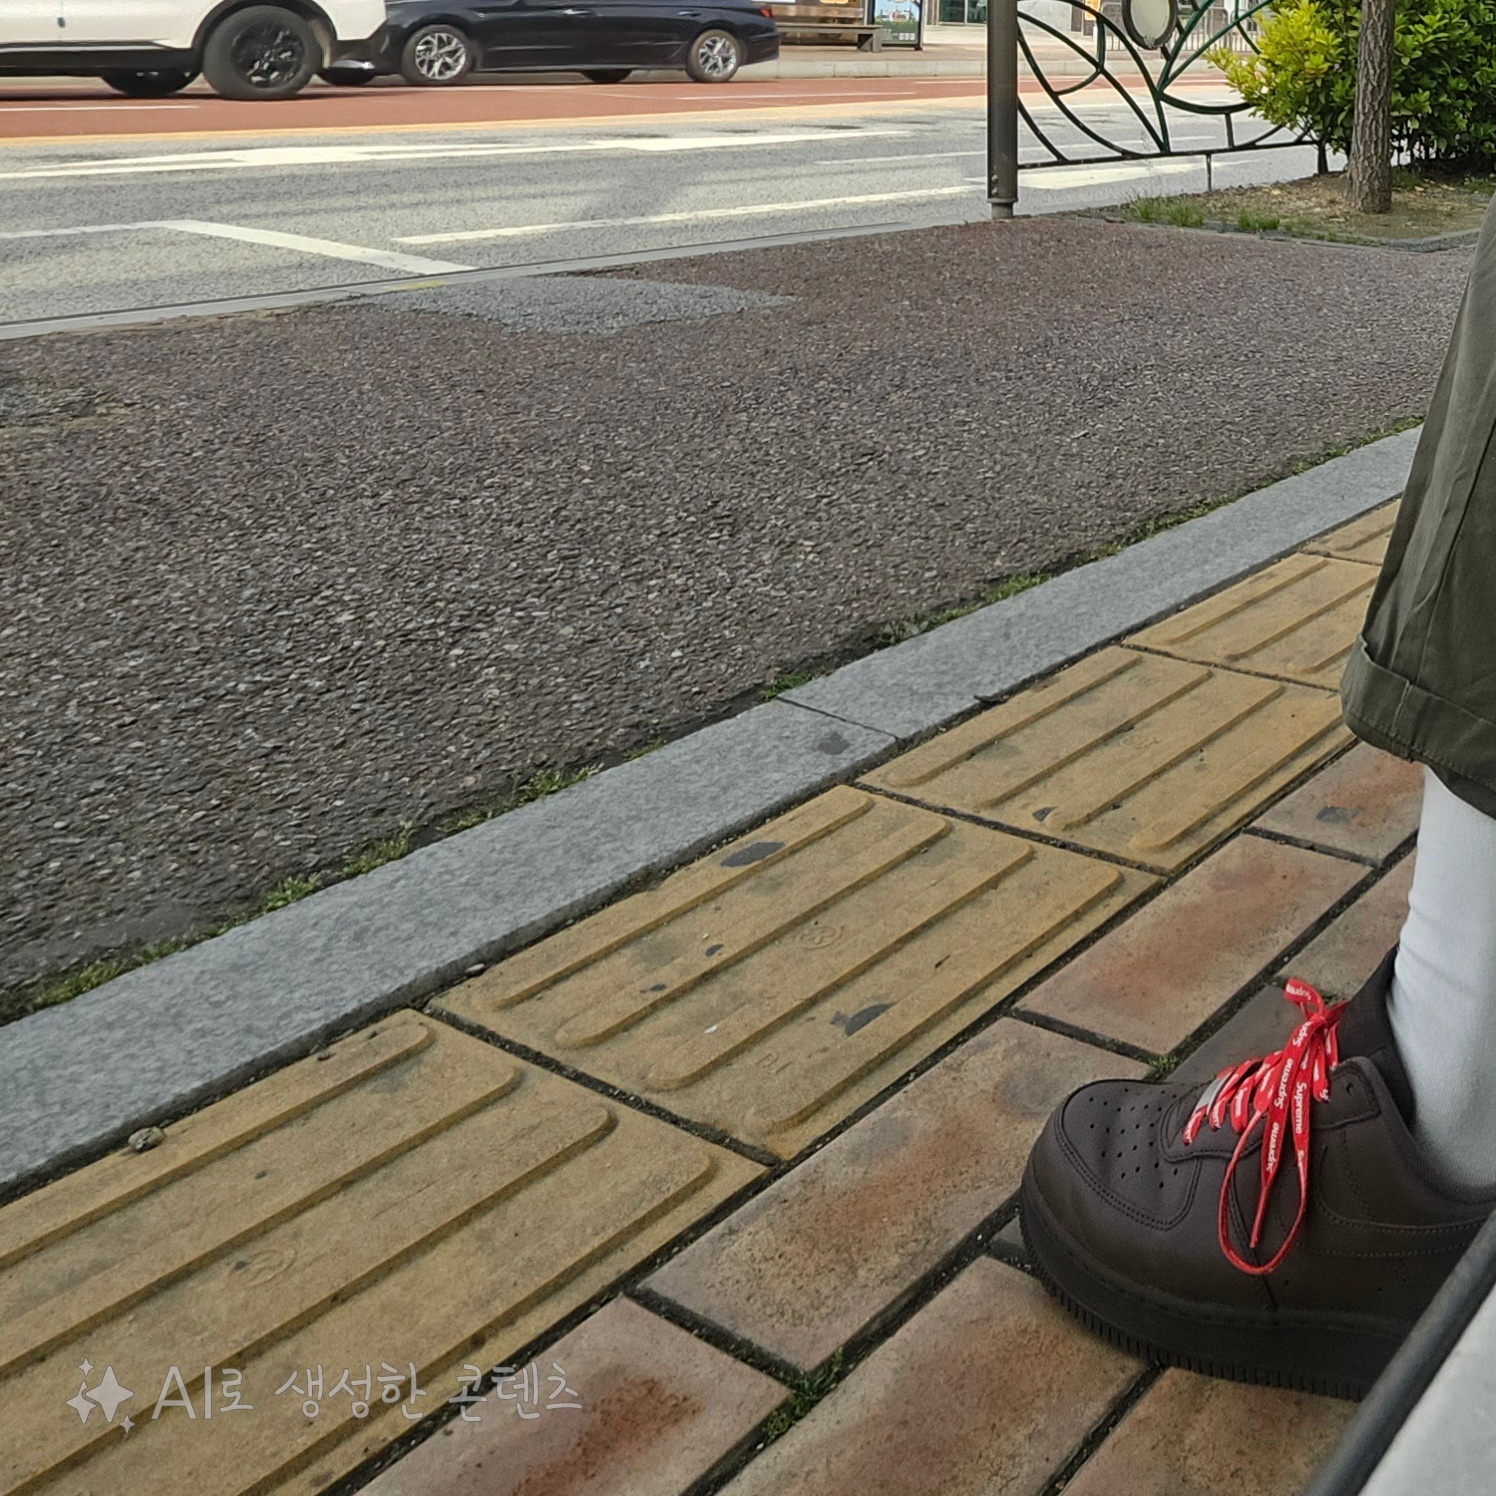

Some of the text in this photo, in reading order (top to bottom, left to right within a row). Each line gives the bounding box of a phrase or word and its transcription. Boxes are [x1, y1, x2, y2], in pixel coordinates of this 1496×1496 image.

[1274, 1058, 1293, 1109] Supreme
[1294, 1082, 1307, 1134] Supreme
[1266, 1121, 1279, 1173] Supreme
